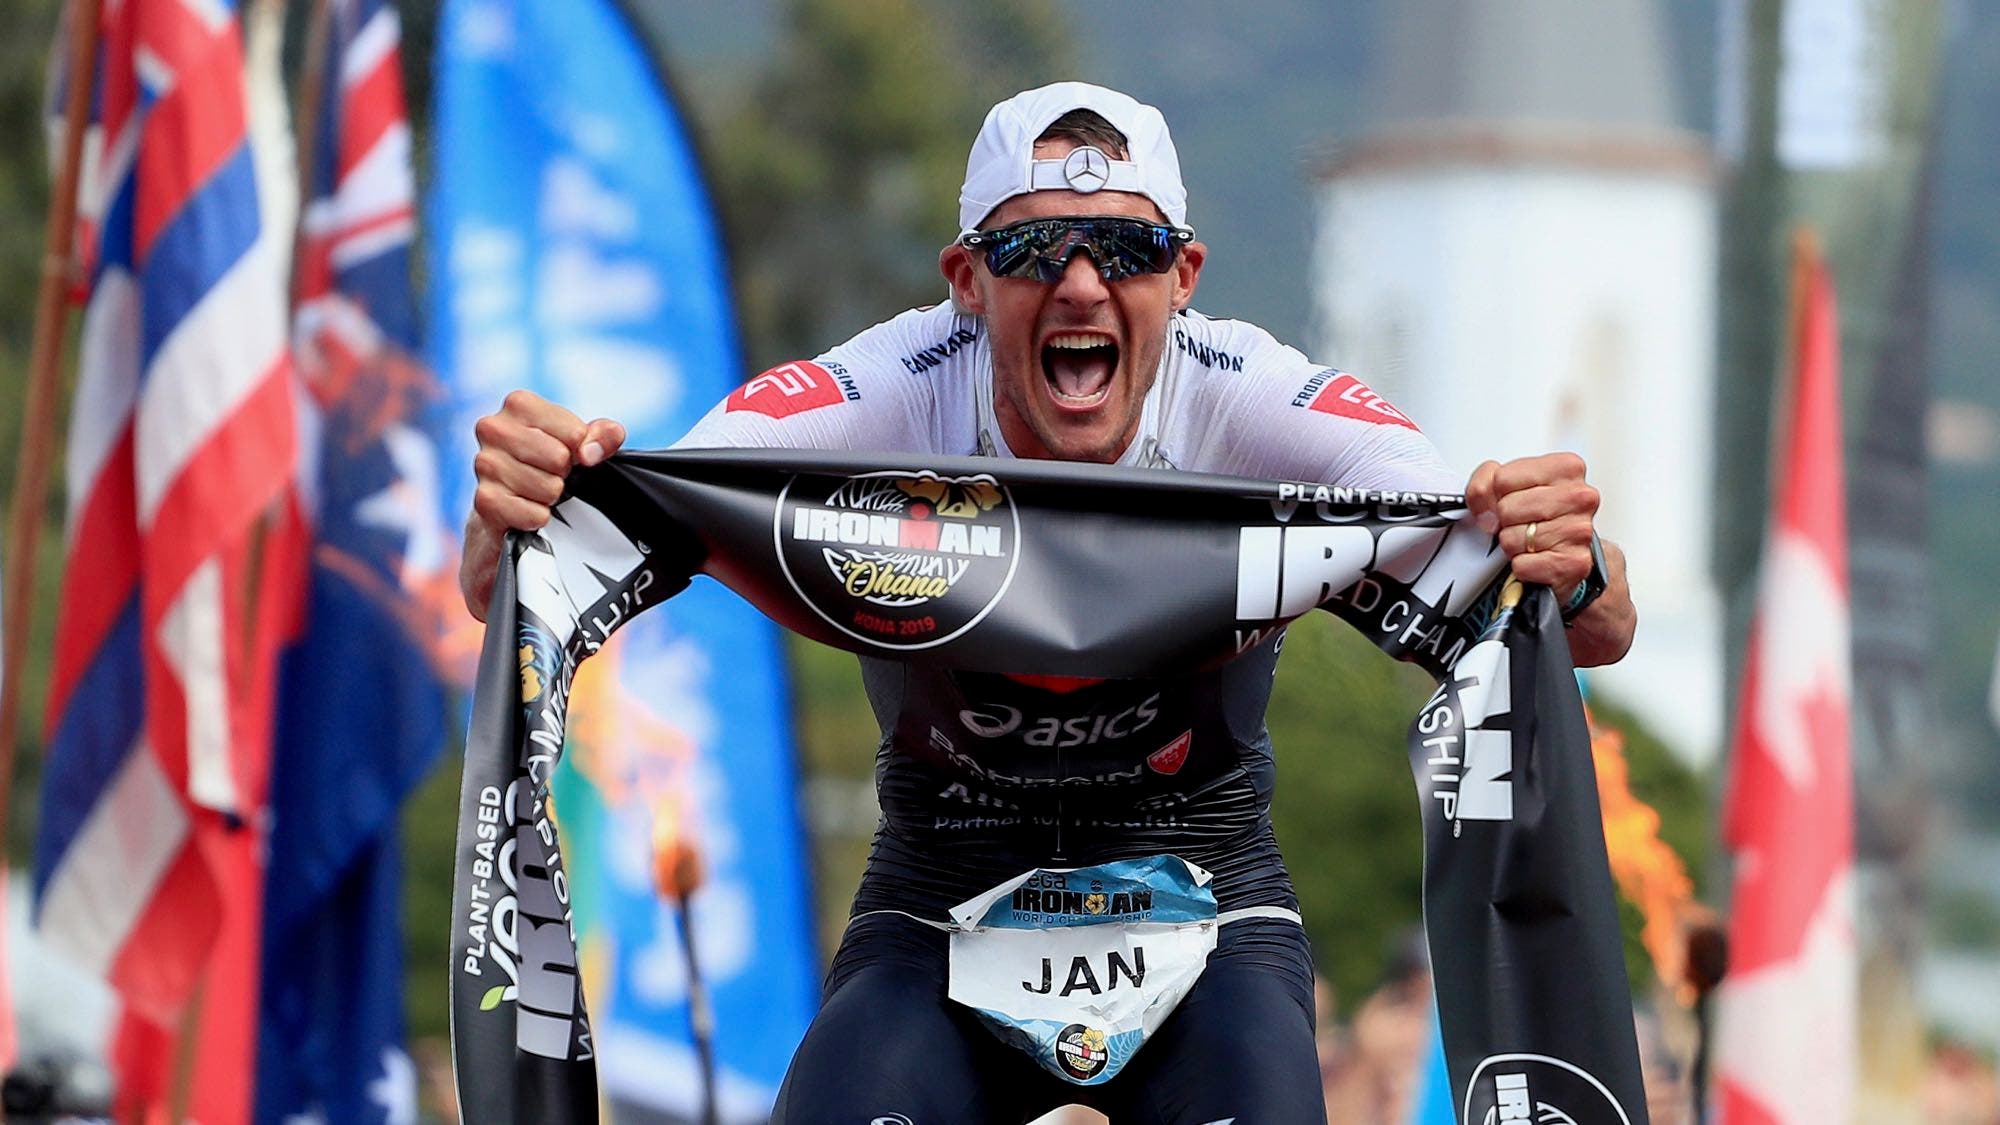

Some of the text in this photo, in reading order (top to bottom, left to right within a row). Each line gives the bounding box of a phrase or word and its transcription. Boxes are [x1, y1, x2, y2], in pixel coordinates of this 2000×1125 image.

[1278, 483, 1466, 505] PLANT-BASE
[793, 507, 1003, 557] IRONMAN
[853, 609, 936, 636] KONA 2019
[464, 786, 501, 976] PLANT-BASED
[1012, 911, 1055, 924] WORLD
[1022, 946, 1146, 997] JAN
